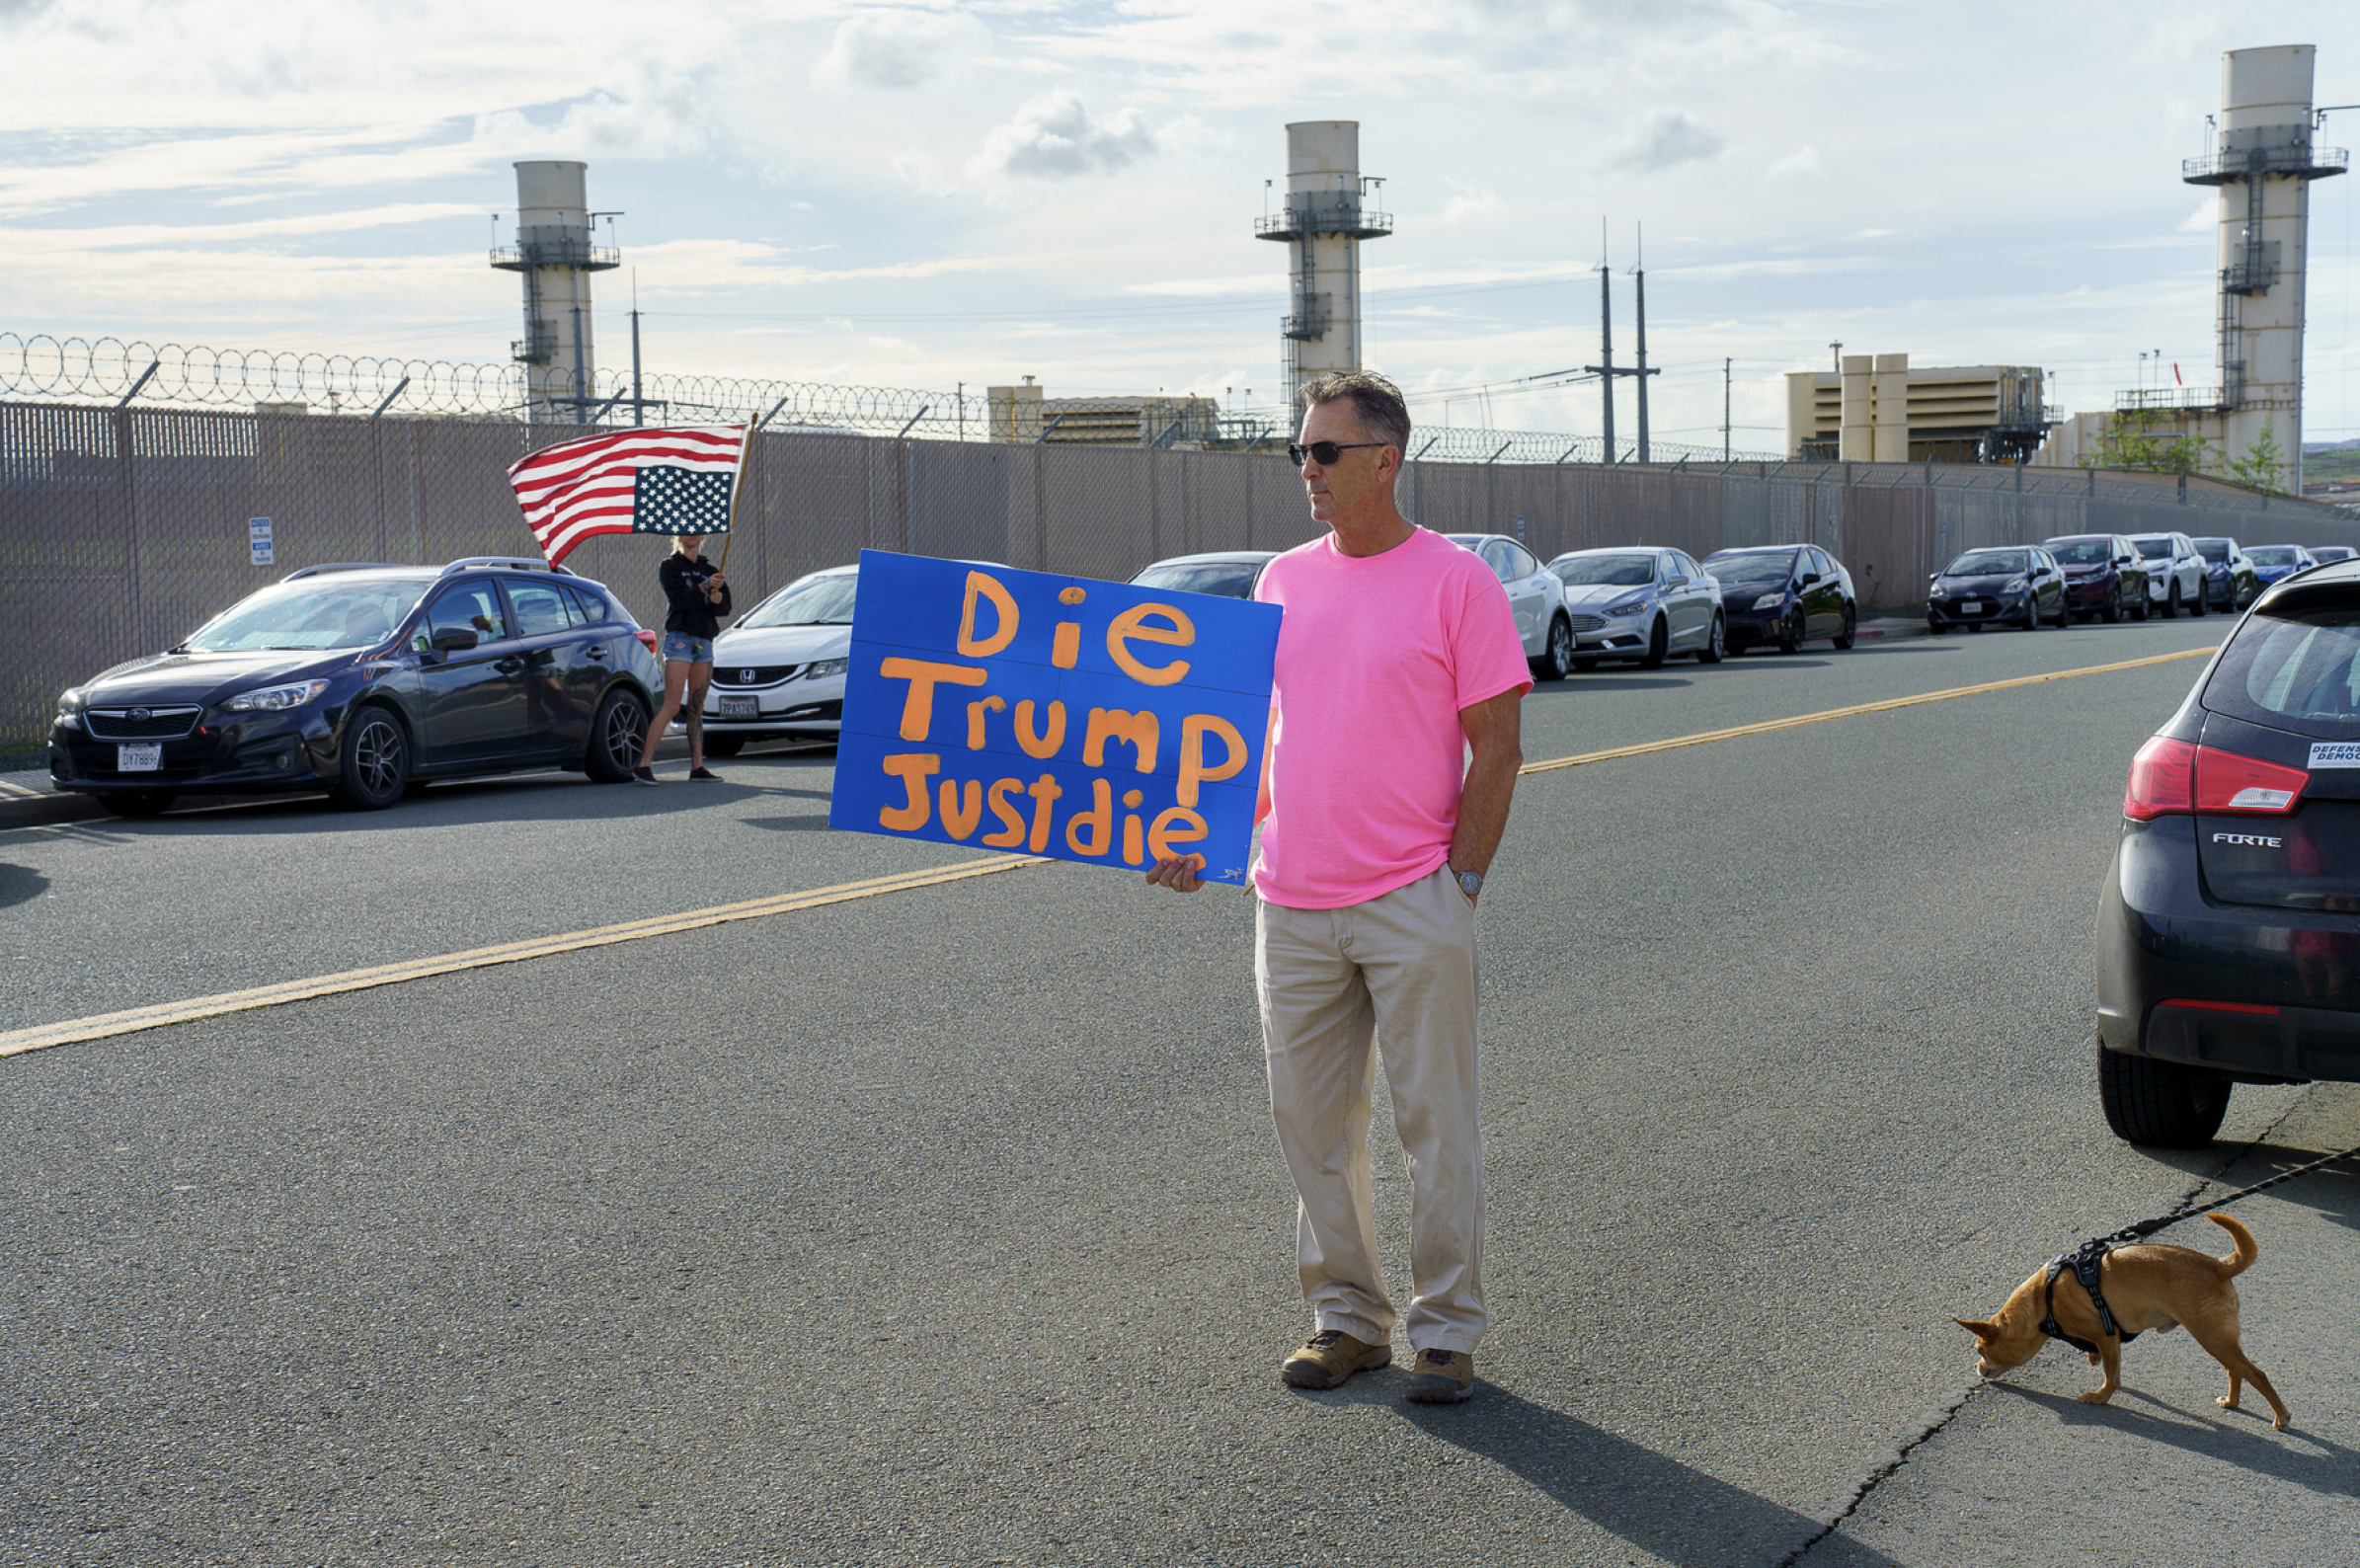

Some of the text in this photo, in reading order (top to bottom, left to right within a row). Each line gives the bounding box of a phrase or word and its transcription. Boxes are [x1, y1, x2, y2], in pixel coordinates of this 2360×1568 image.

[957, 570, 1196, 686] Die
[880, 657, 1249, 809] Trump
[2213, 832, 2282, 848] FORTE
